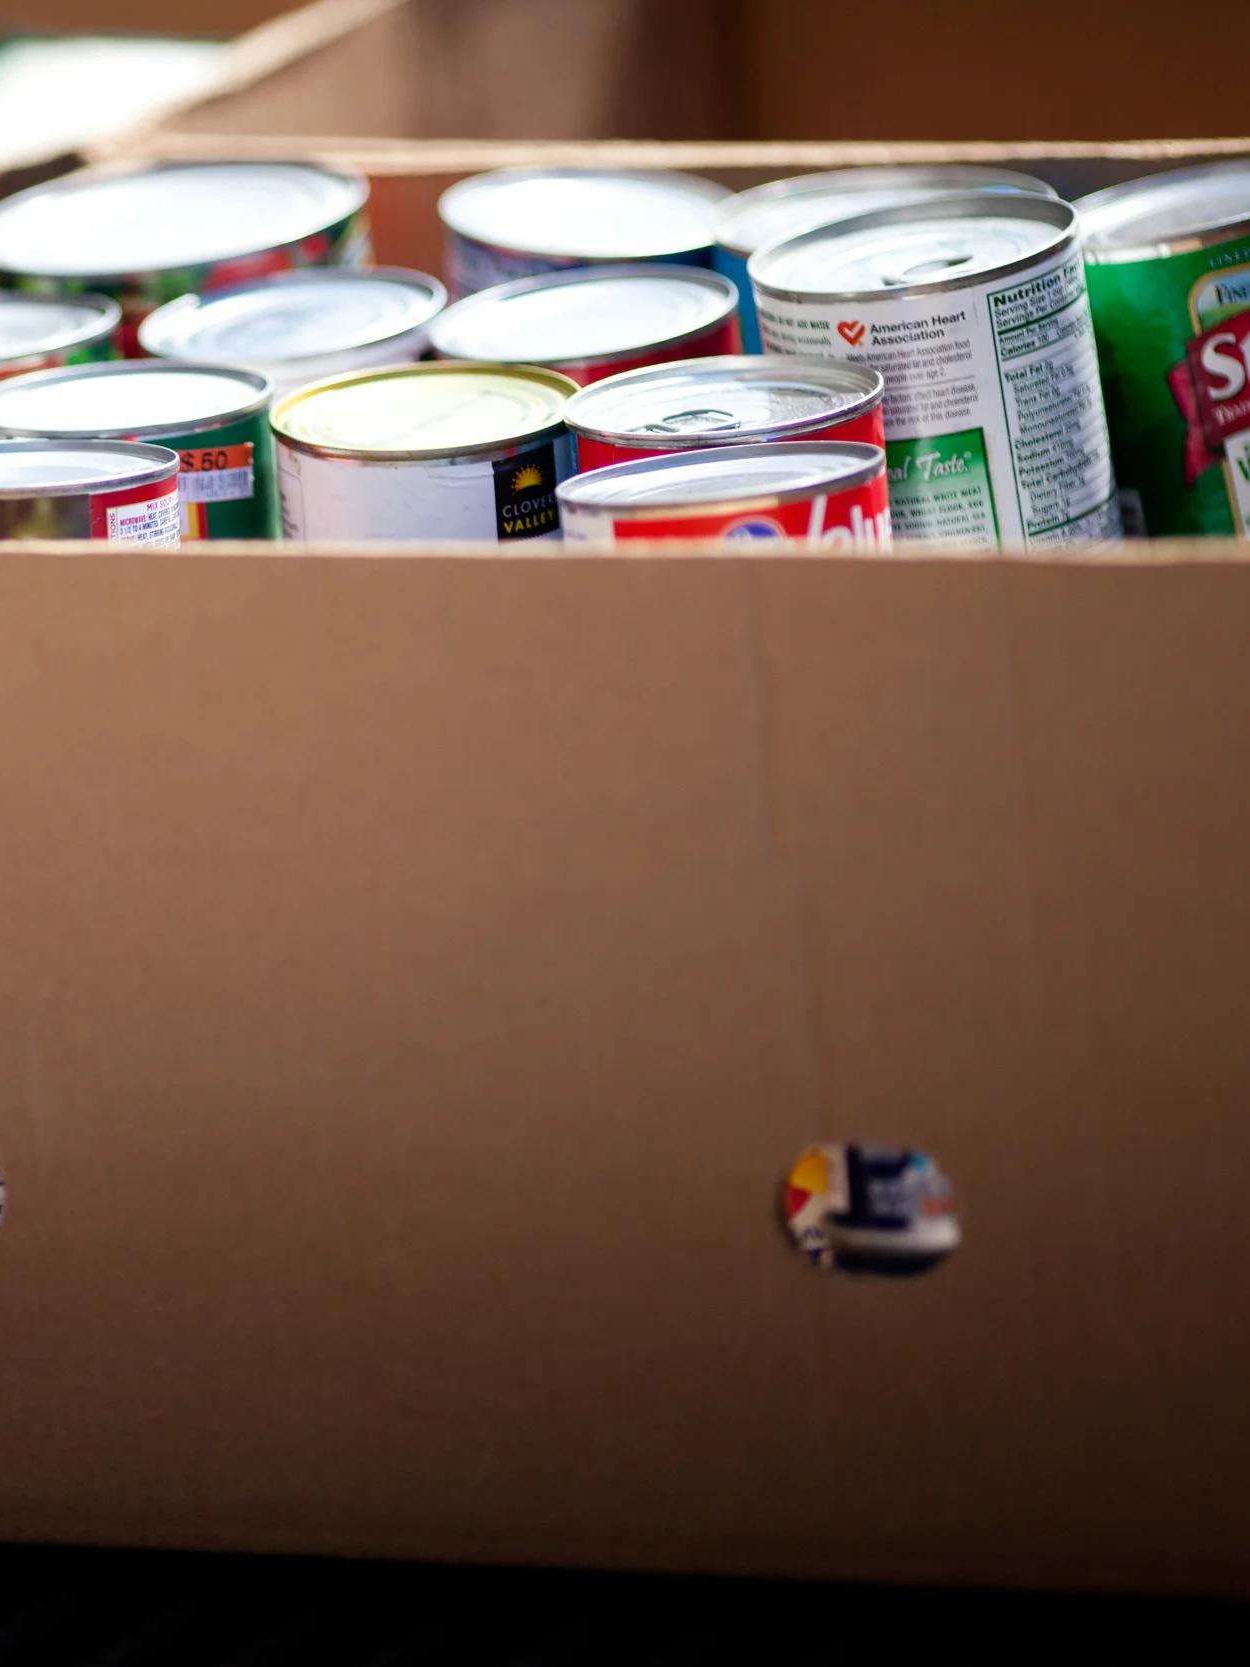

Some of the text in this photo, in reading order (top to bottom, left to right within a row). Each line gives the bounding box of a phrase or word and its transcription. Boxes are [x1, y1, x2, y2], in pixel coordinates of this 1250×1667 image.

[993, 274, 1061, 307] Nutrition
[995, 301, 1028, 318] Serving
[870, 310, 966, 335] American Heart
[996, 311, 1034, 328] Servings
[871, 328, 945, 347] Association
[1000, 341, 1035, 357] Calories
[935, 350, 972, 366] cholesterol
[886, 373, 907, 384] people
[926, 370, 941, 381] age
[1004, 369, 1027, 382] Total
[1030, 364, 1043, 375] Fat
[1015, 427, 1064, 449] Cholesterol
[1016, 449, 1050, 462] Sodium
[1018, 457, 1064, 476] Potassium
[1021, 478, 1044, 489] Total
[933, 492, 958, 501] WHITE
[961, 486, 982, 496] MEAT
[147, 501, 158, 511] MIX
[502, 493, 554, 518] CLOVER
[503, 509, 554, 533] VALLEY
[972, 512, 987, 521] SEA
[1027, 515, 1059, 529] Protein
